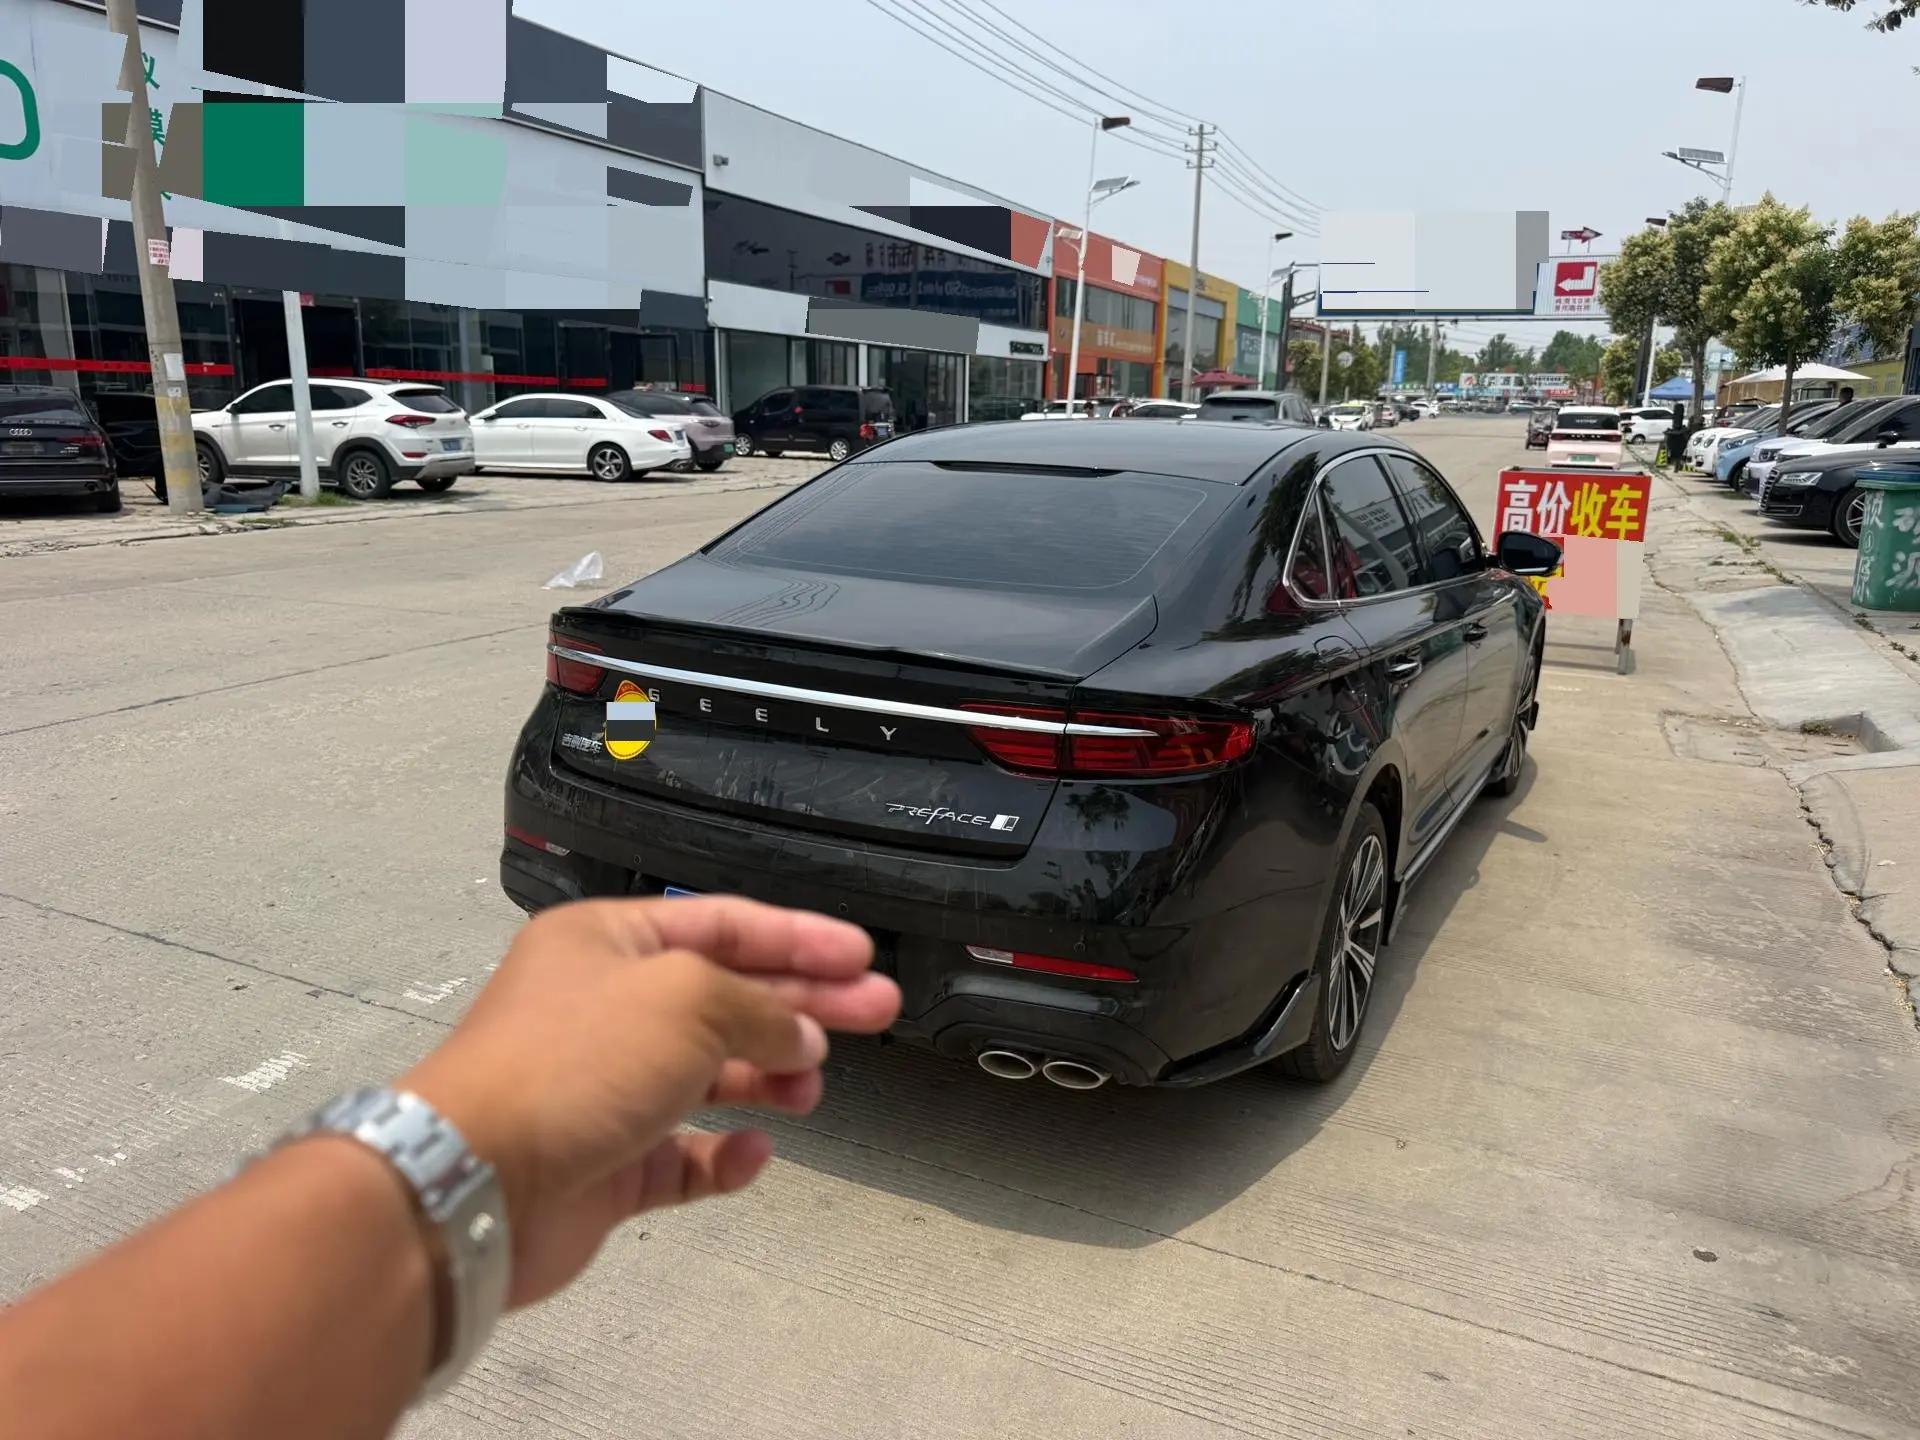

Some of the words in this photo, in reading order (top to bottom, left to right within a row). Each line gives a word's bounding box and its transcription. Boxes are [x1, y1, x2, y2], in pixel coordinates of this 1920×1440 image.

[1501, 480, 1643, 541] 高价收车
[648, 687, 897, 741] GEELY
